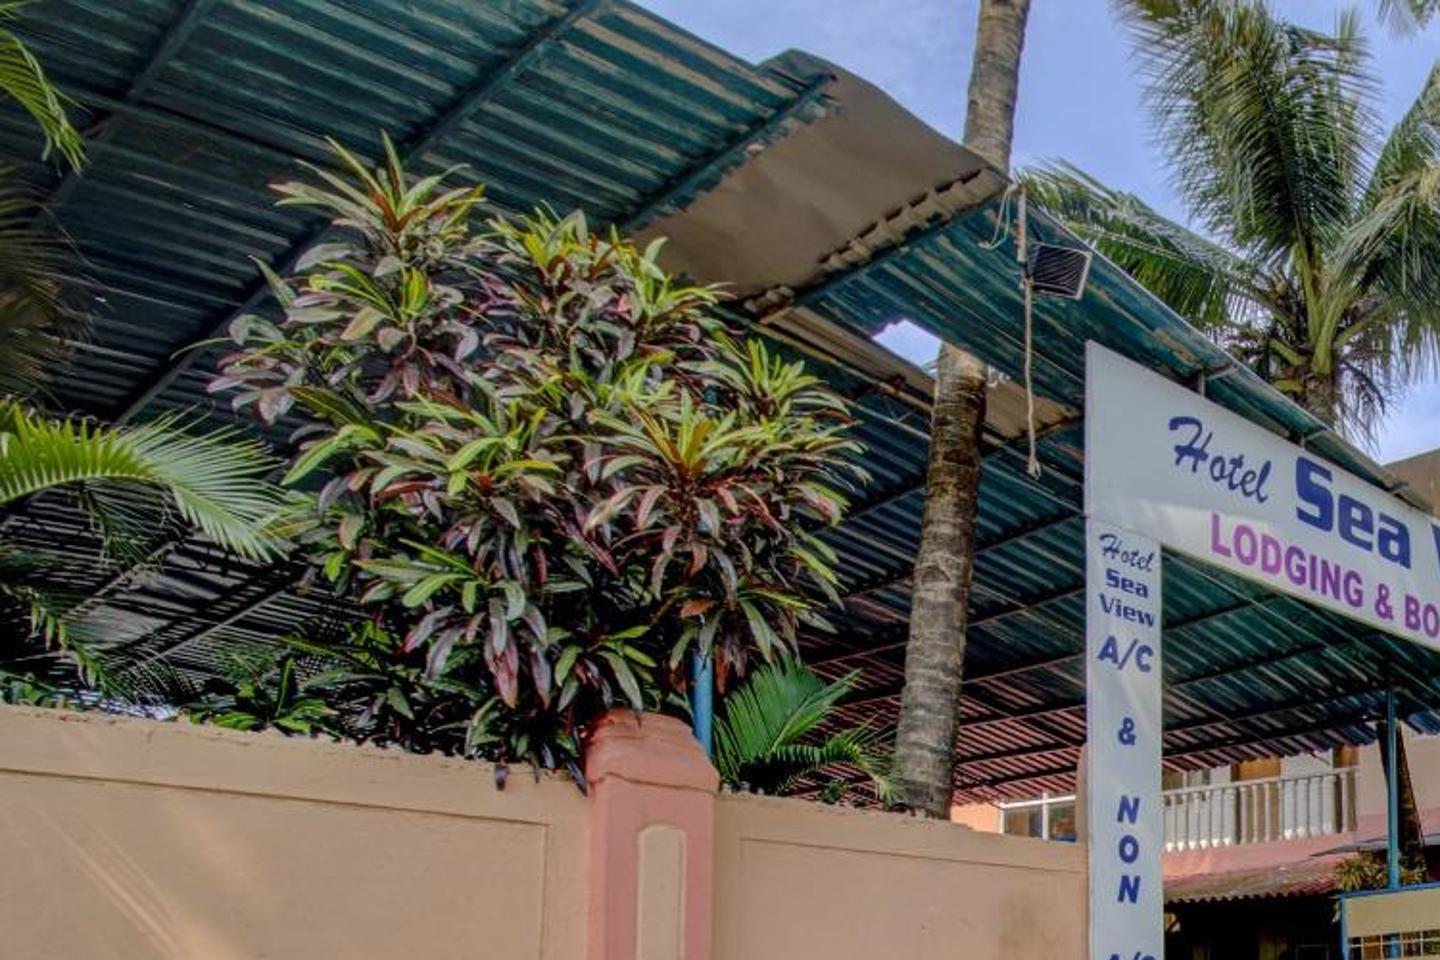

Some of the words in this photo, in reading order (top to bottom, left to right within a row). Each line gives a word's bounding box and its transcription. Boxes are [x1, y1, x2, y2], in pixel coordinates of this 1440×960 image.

[1168, 416, 1273, 502] Hotel
[1295, 456, 1412, 569] Sea
[1100, 533, 1154, 573] Hotel
[1210, 513, 1364, 608] LODGING
[1375, 583, 1395, 621] &
[1105, 567, 1149, 599] Sea
[1099, 593, 1155, 627] View
[1098, 635, 1153, 672] A/C
[1117, 717, 1137, 745] &
